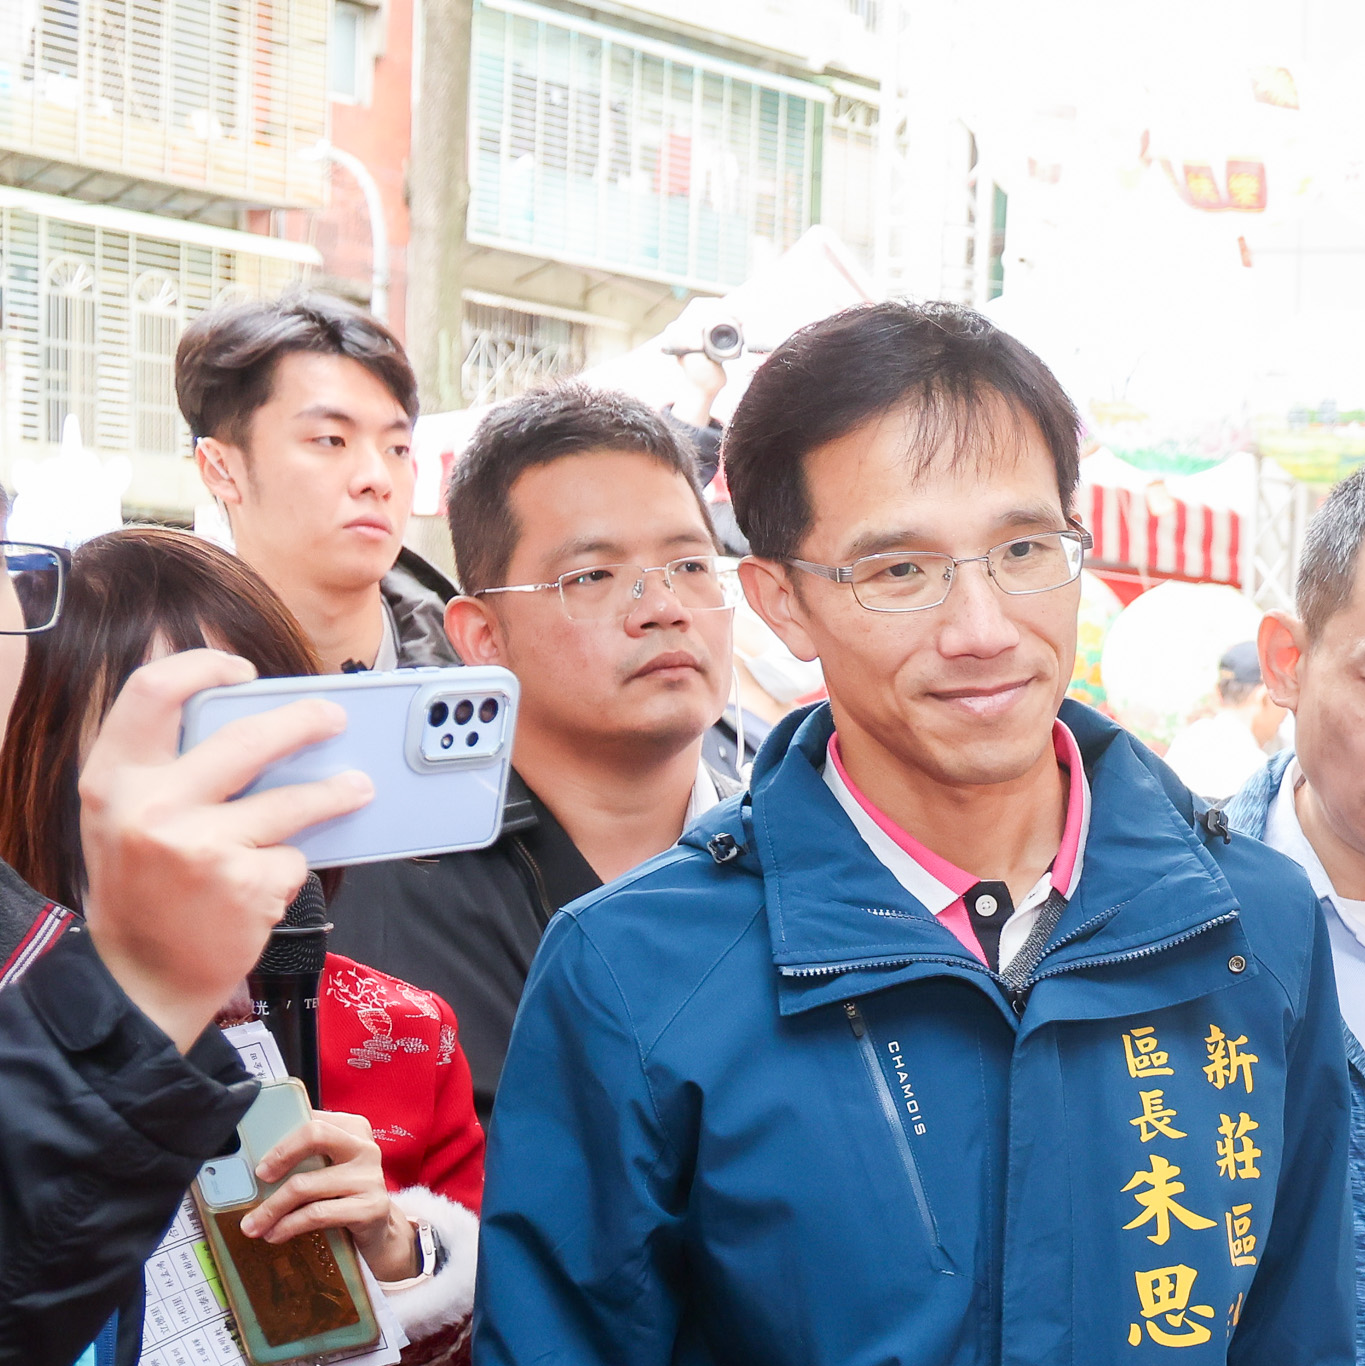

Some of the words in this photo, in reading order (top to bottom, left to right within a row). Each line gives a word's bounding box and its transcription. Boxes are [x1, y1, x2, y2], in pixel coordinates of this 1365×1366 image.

[887, 1040, 928, 1136] CHAMOIS
[1202, 1022, 1263, 1338] 新莊區
